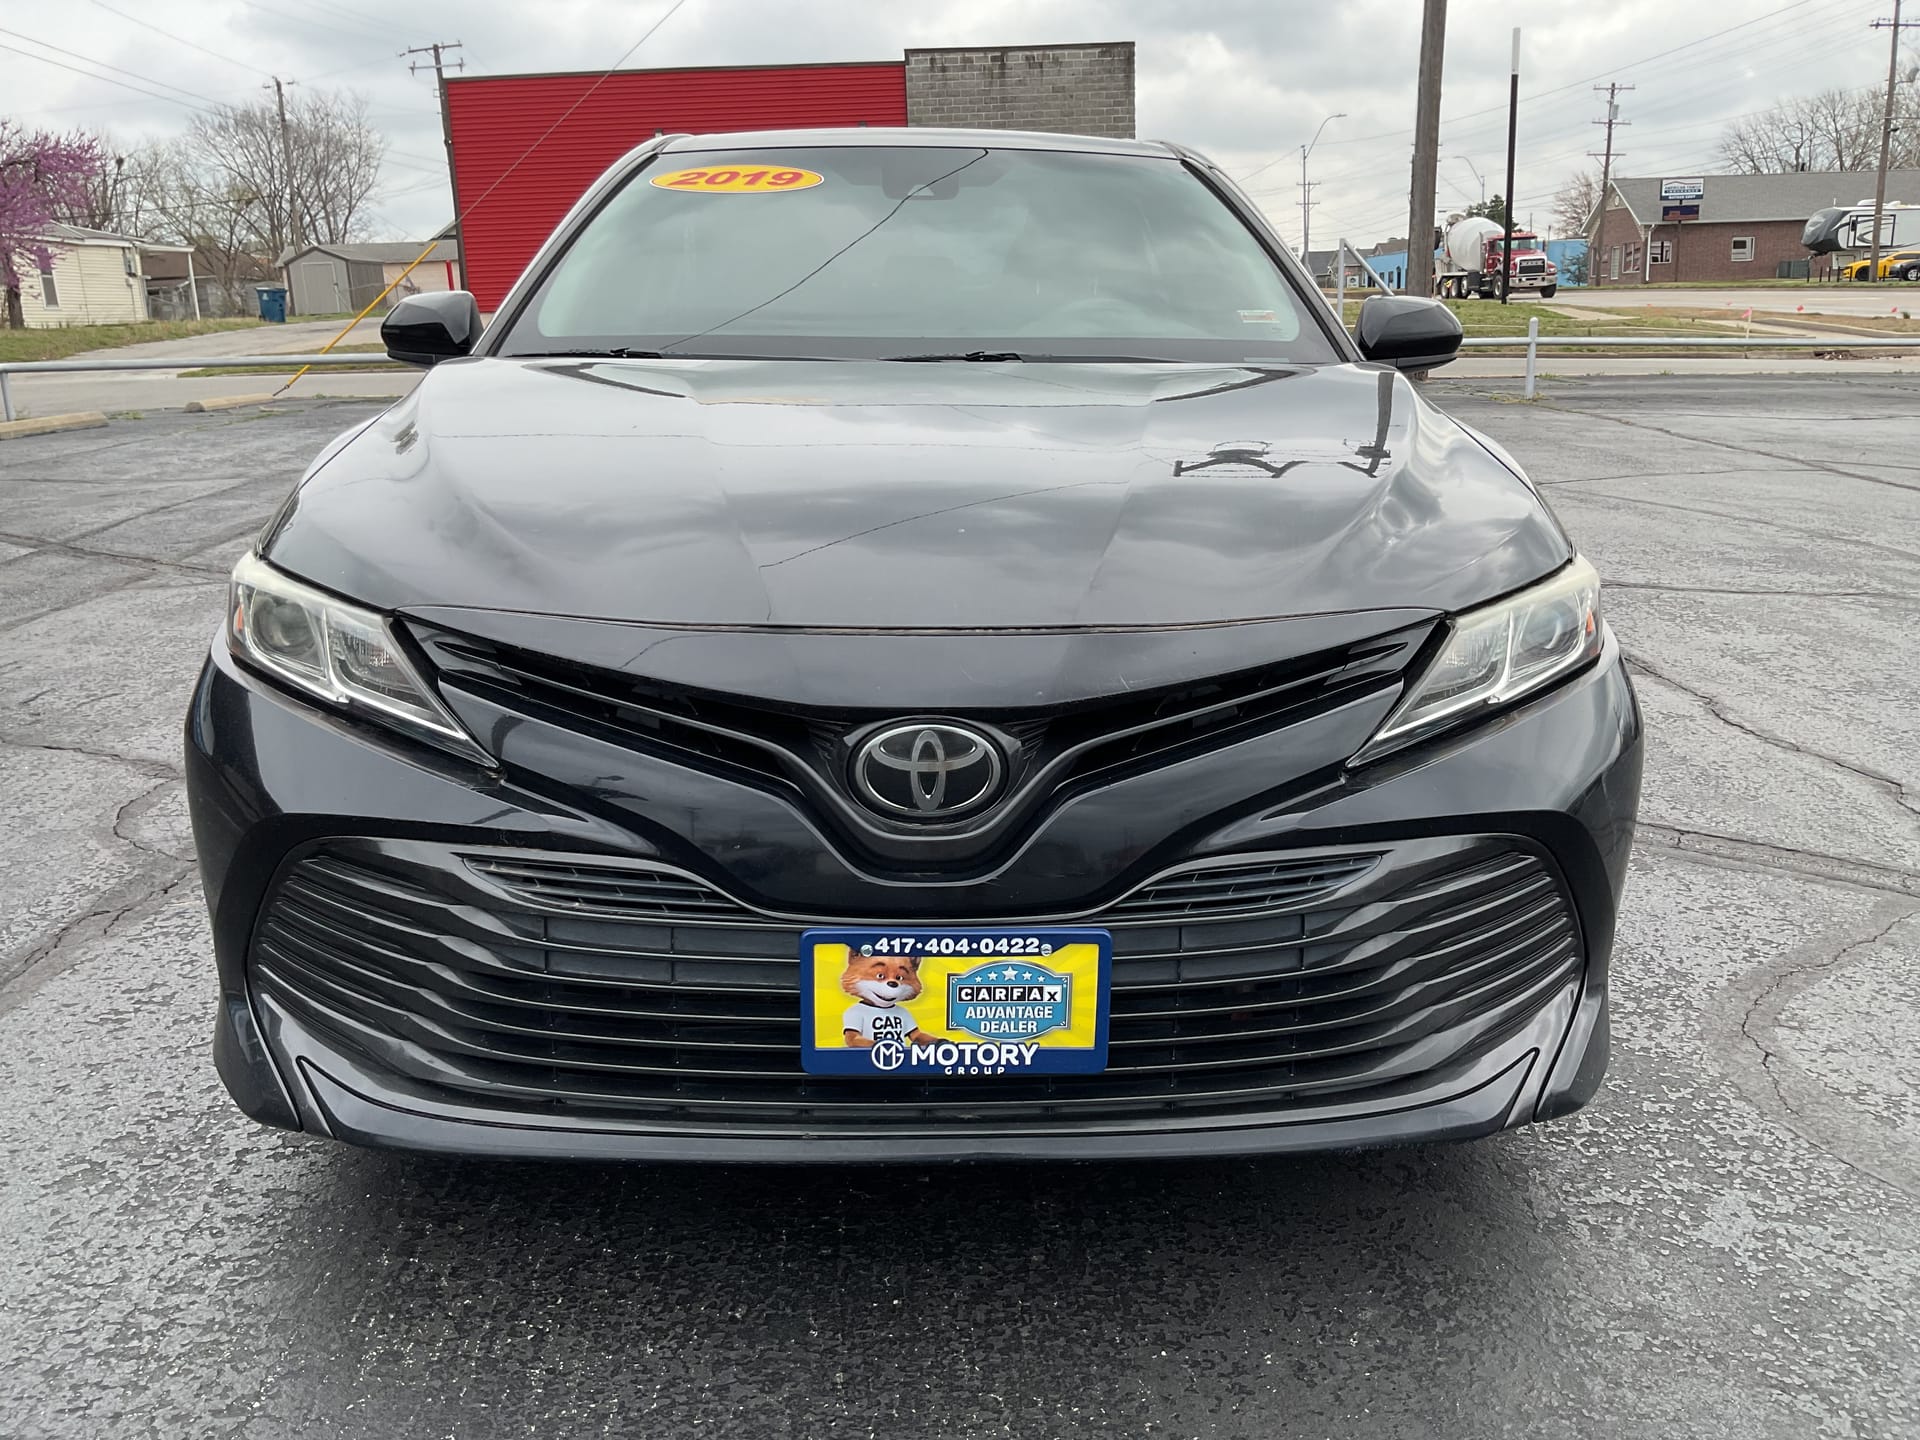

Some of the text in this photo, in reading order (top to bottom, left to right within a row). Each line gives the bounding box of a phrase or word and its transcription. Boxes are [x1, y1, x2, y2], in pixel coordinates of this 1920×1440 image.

[667, 170, 804, 187] 2019
[960, 987, 1059, 1002] CARFAX
[965, 1006, 1053, 1019] ADVANTAGE
[872, 1016, 903, 1030] CAR
[980, 1021, 1038, 1033] DEALER
[911, 1043, 1039, 1066] MOTORY
[944, 1066, 1005, 1075] GROUP
